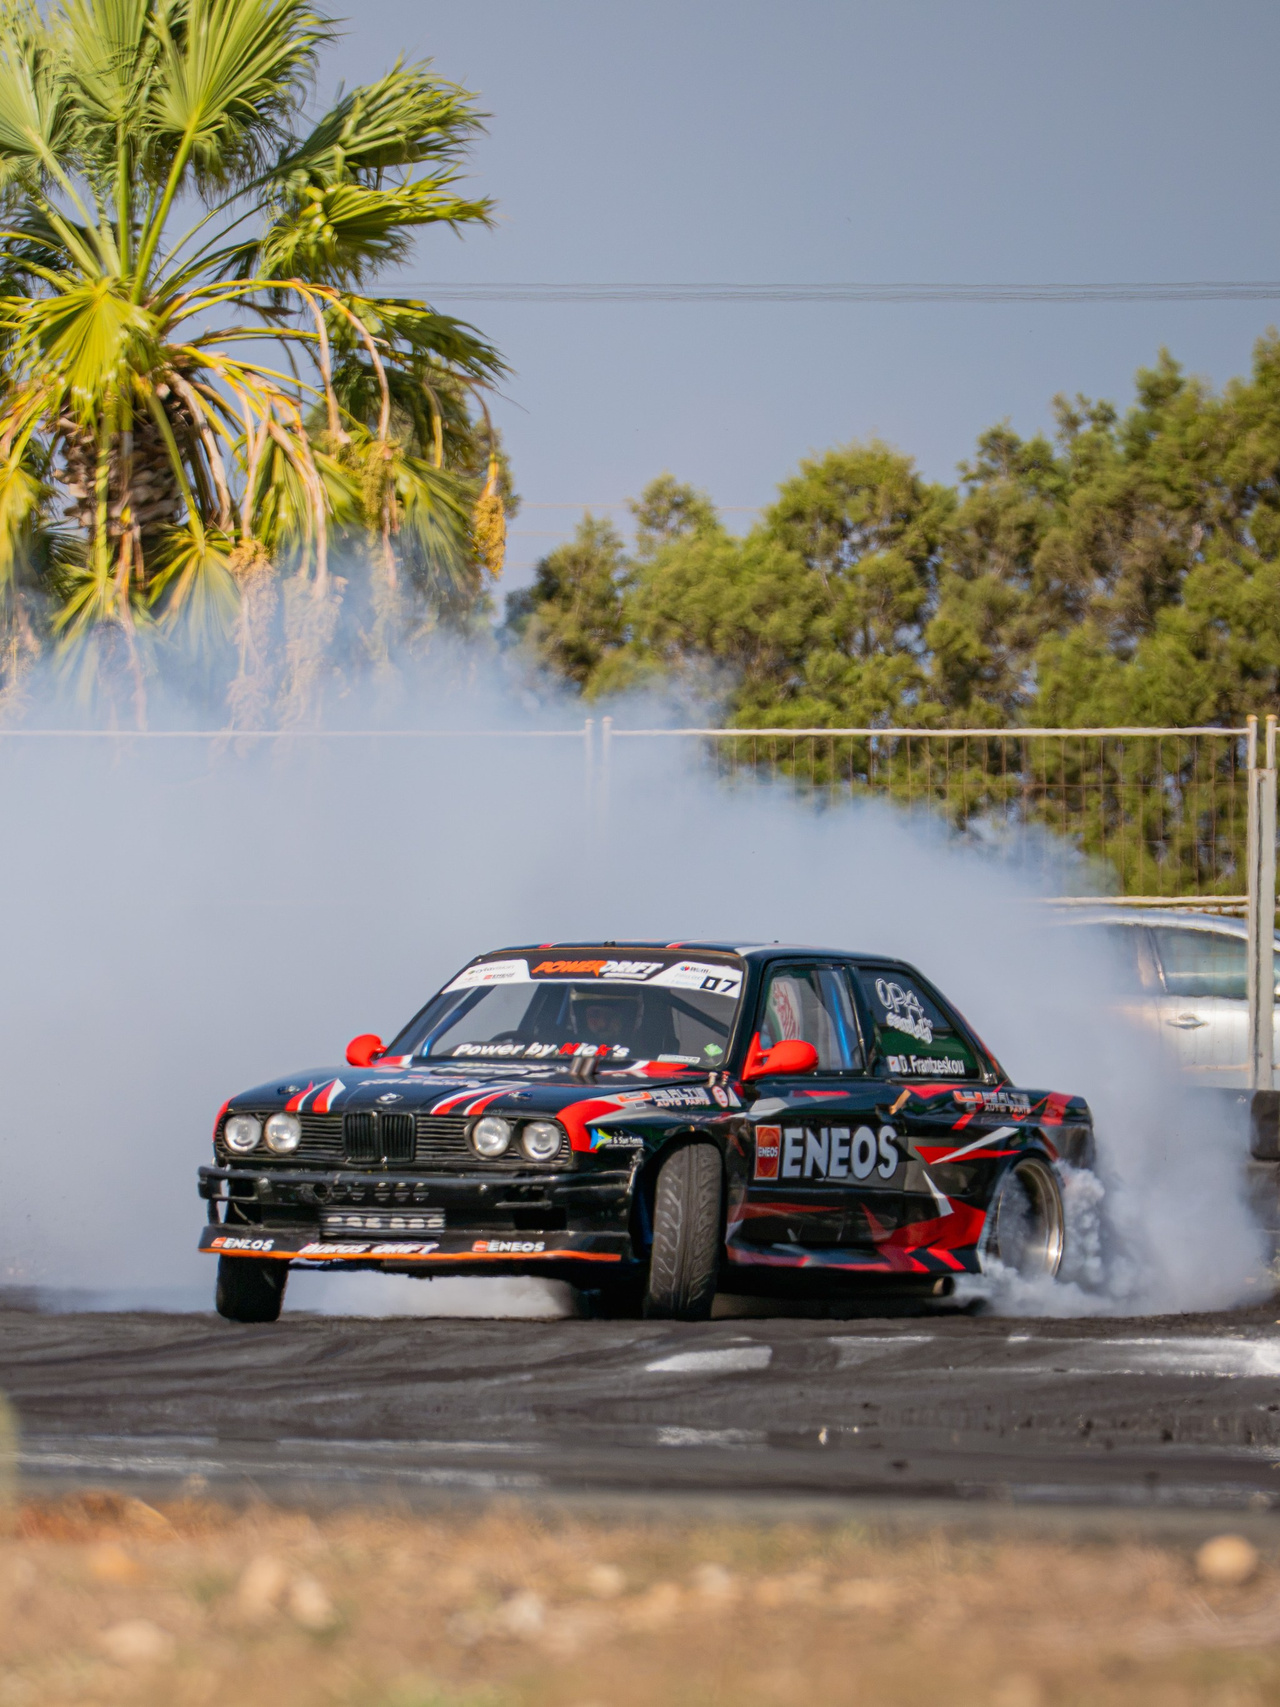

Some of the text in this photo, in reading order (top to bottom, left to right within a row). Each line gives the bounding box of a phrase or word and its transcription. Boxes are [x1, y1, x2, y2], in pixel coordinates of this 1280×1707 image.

[700, 975, 740, 992] 07
[452, 1043, 526, 1057] Power
[523, 1042, 558, 1059] by
[758, 1146, 779, 1158] ENEOS
[782, 1124, 898, 1180] ENEOS
[222, 1237, 275, 1252] ENEOS
[487, 1240, 546, 1253] ENEOS
